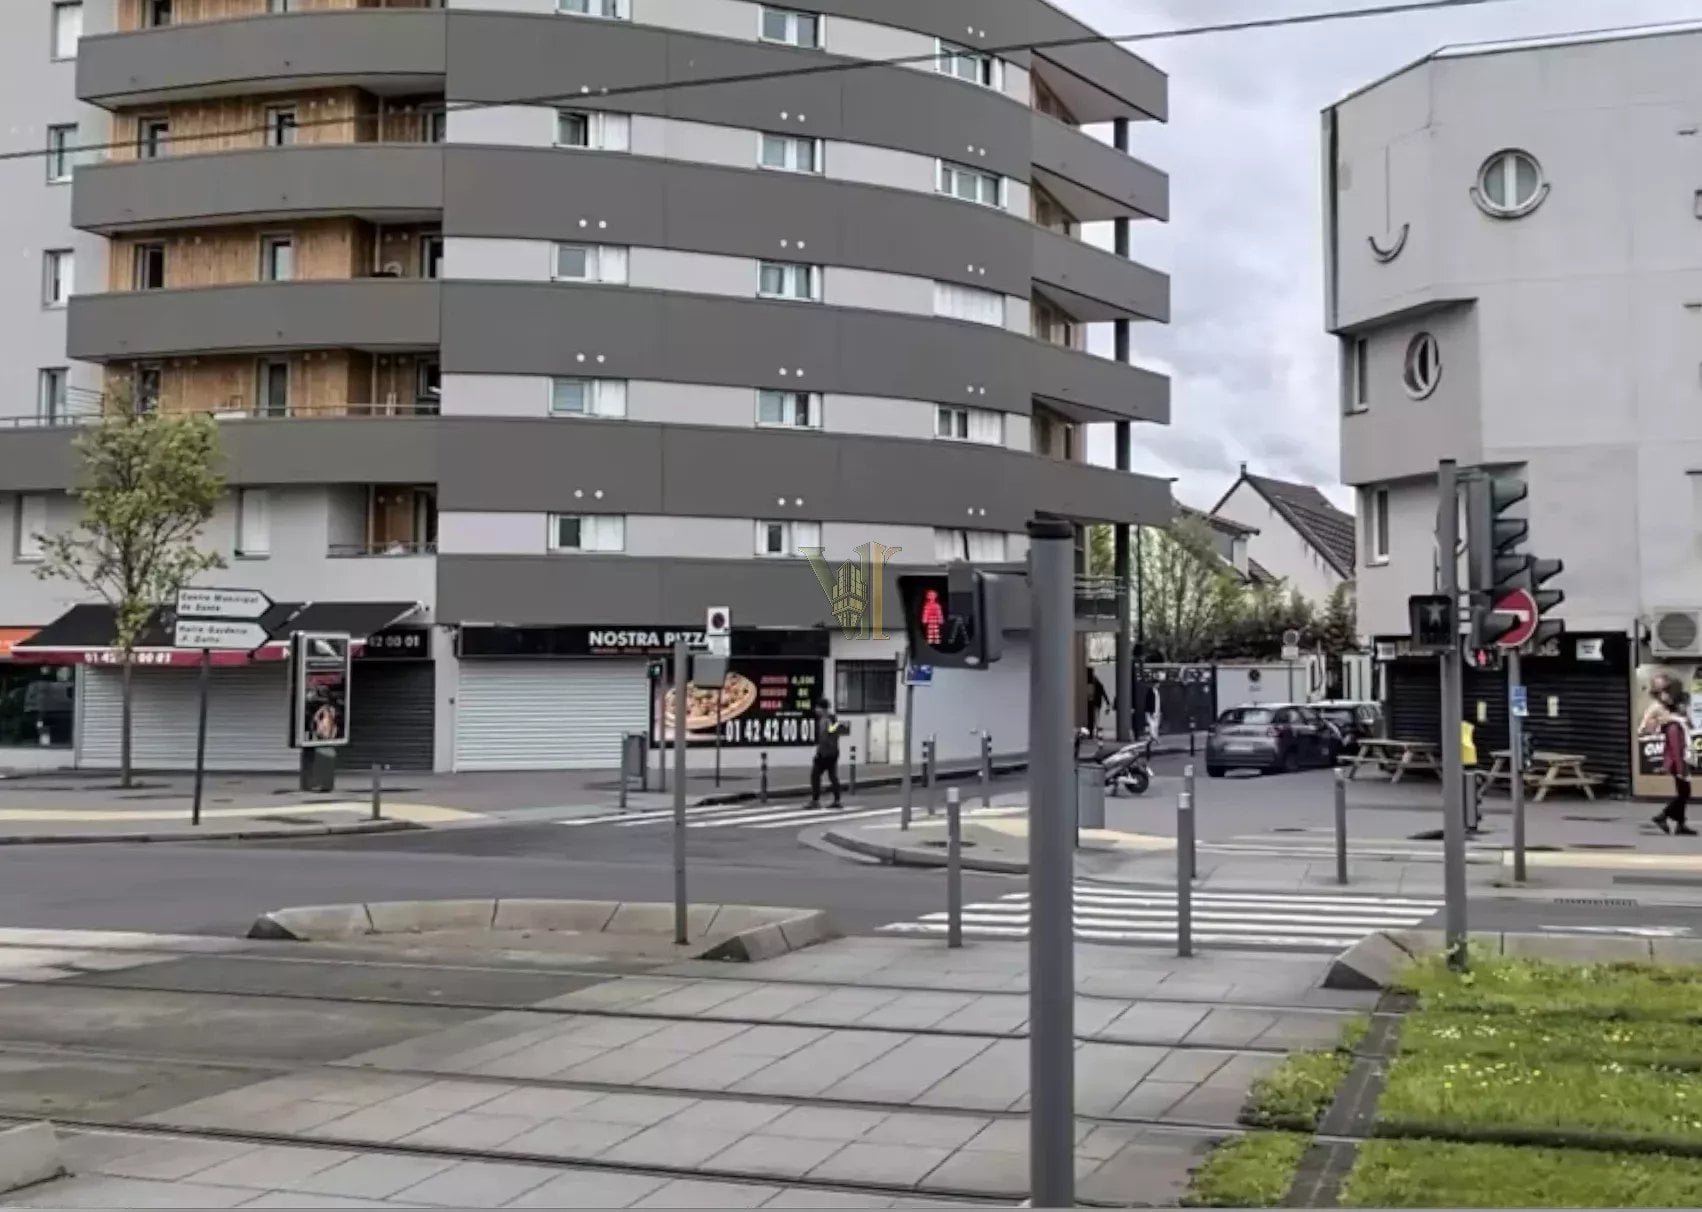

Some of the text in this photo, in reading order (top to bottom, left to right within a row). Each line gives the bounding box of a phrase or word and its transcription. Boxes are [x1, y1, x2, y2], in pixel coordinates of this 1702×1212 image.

[404, 635, 420, 647] 01
[588, 631, 660, 647] NOSTRA
[726, 719, 816, 742] 01 42 42 00 01
